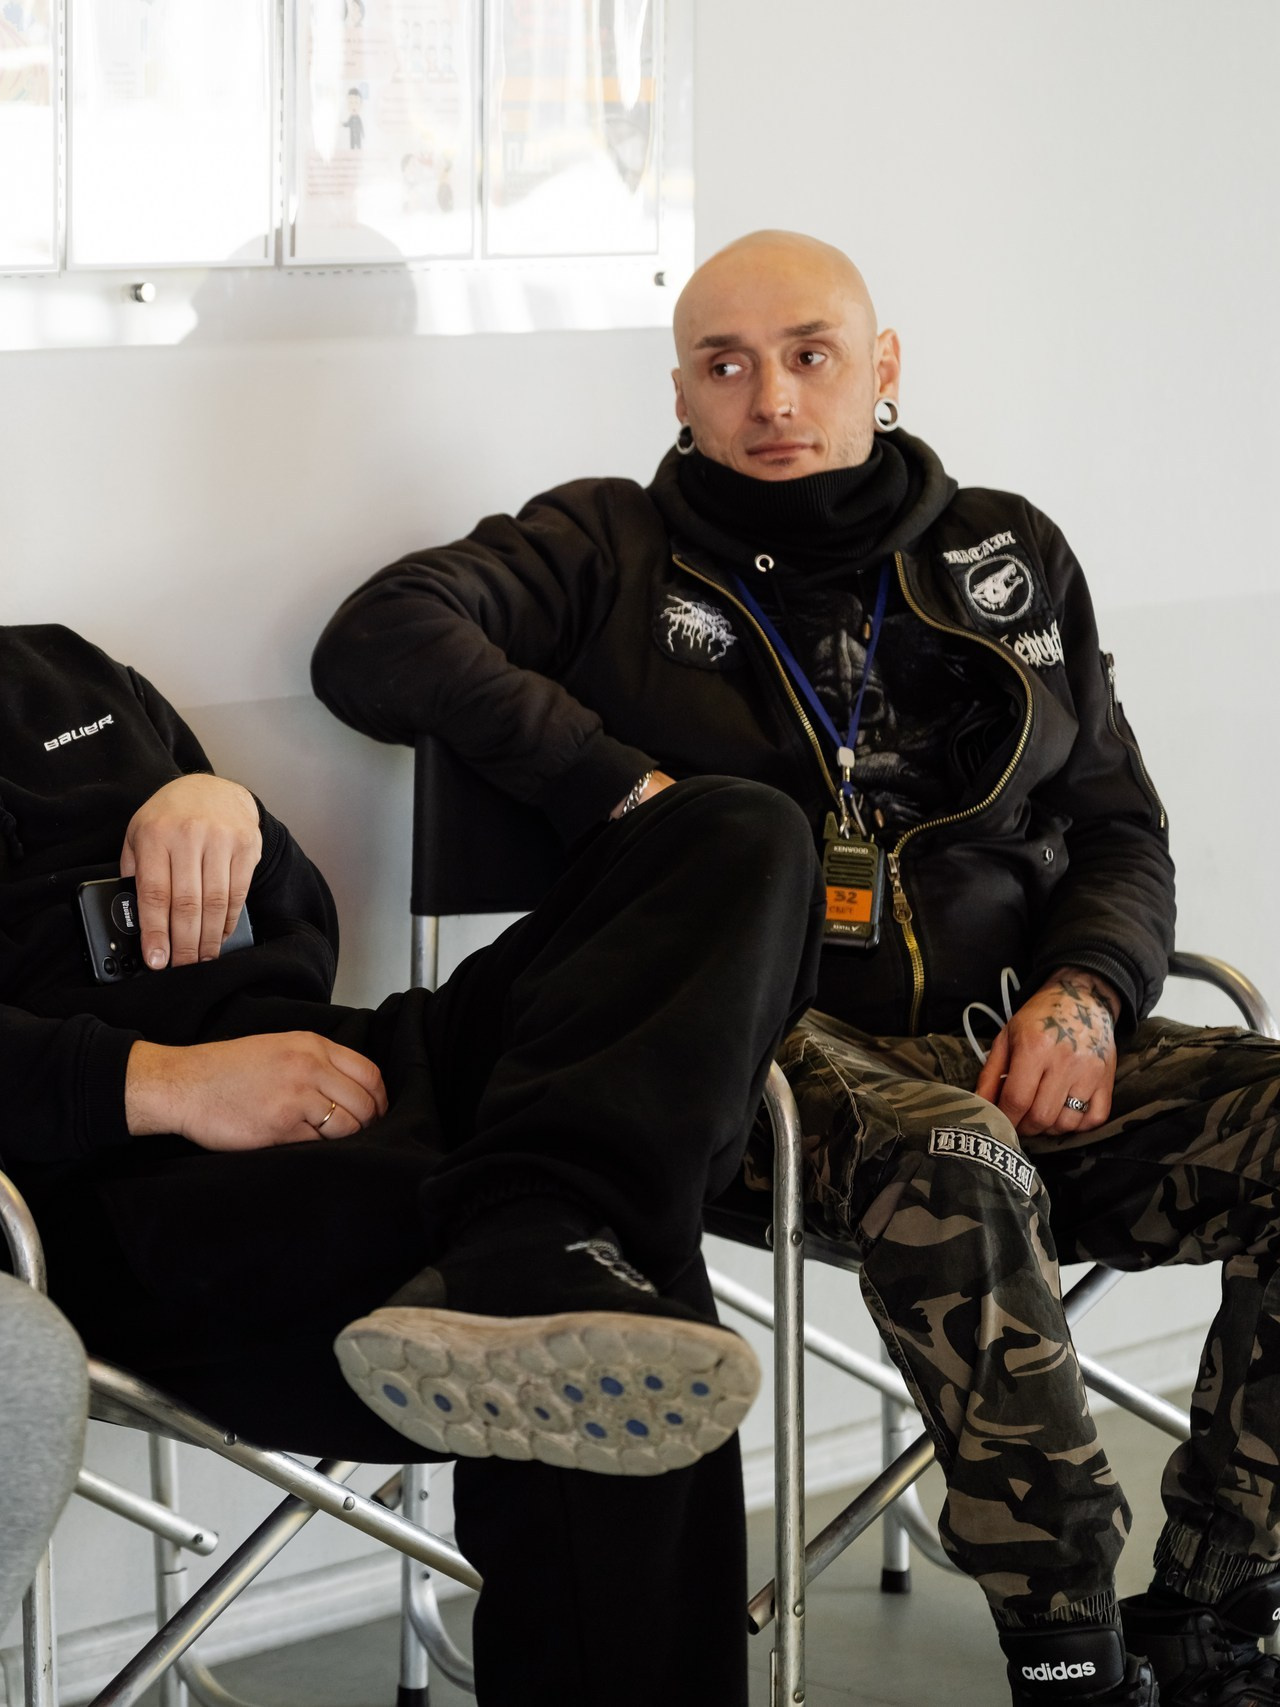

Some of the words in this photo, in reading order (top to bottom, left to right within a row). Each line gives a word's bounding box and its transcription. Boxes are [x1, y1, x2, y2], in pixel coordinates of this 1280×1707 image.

[833, 845, 869, 855] KENWOOD
[936, 1130, 1031, 1189] BURZUM
[1021, 1661, 1097, 1682] adidas
